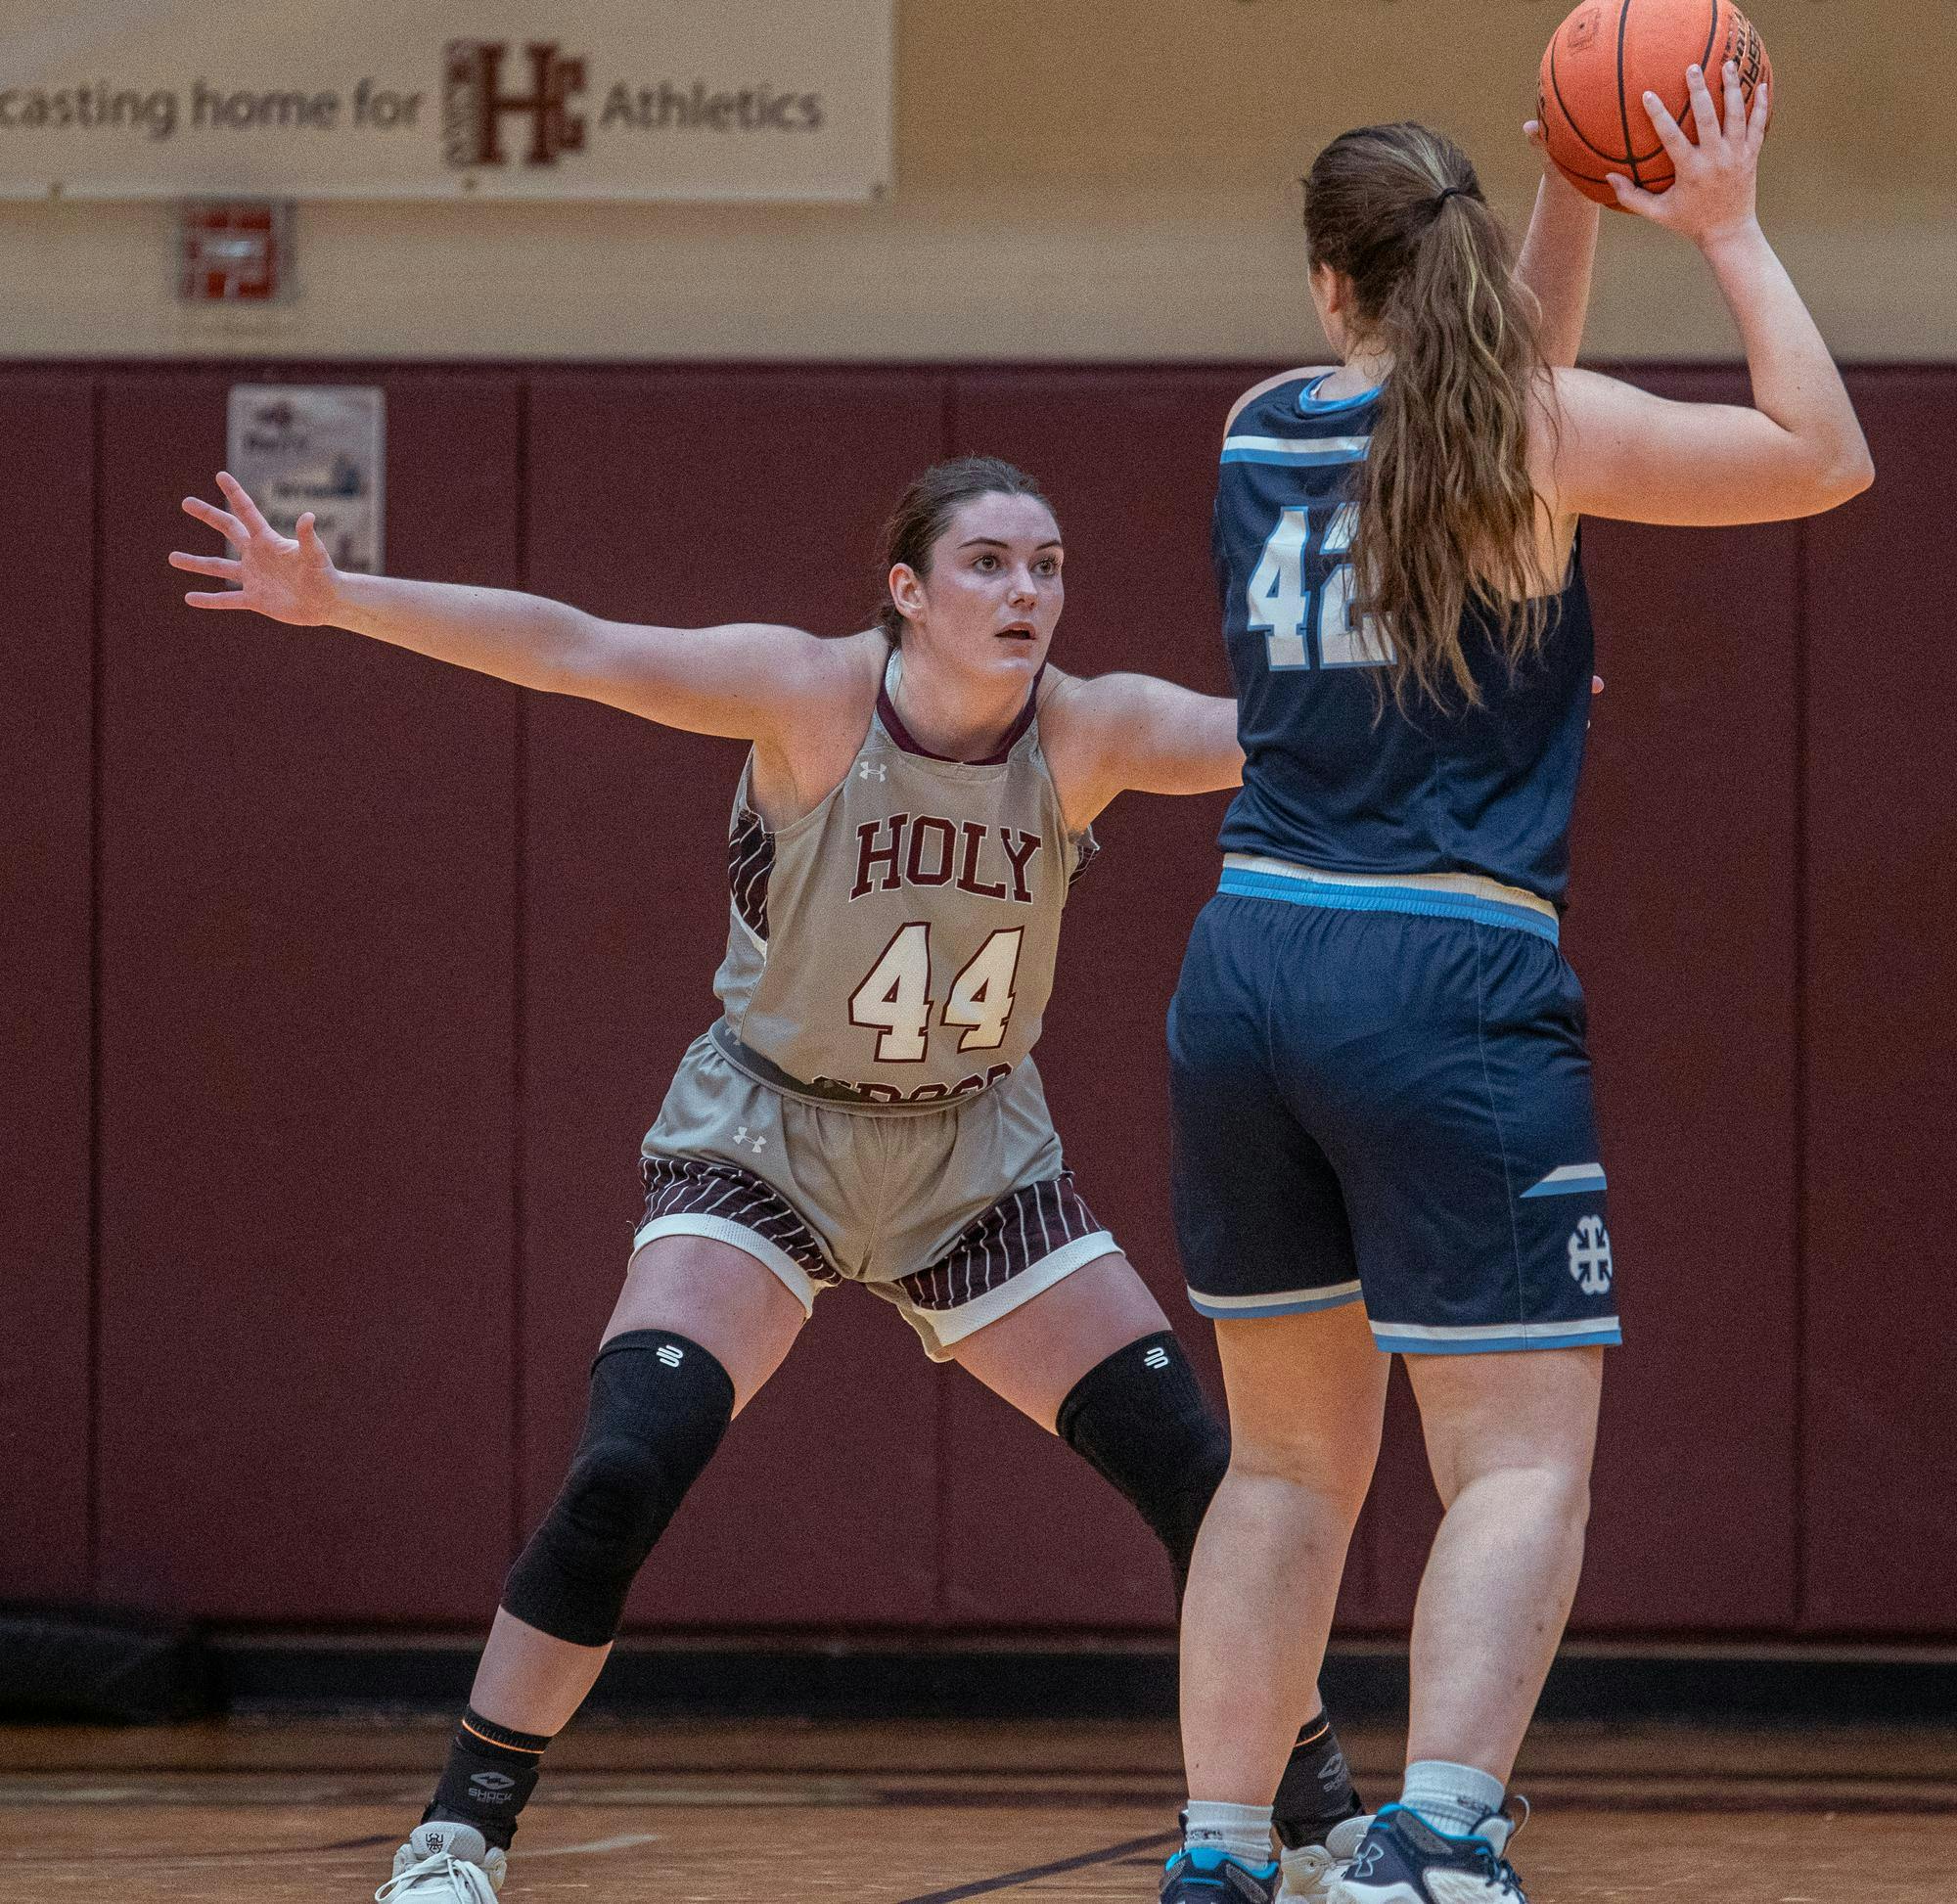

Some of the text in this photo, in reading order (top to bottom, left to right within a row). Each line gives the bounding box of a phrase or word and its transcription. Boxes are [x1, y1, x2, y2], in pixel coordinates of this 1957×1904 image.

[192, 78, 339, 130] home
[353, 77, 424, 130] for
[600, 80, 824, 131] Athletics
[1247, 502, 1397, 671] 42
[849, 812, 1042, 905] HOLY
[847, 922, 1025, 1064] 44
[469, 1788, 513, 1801] SHOCK
